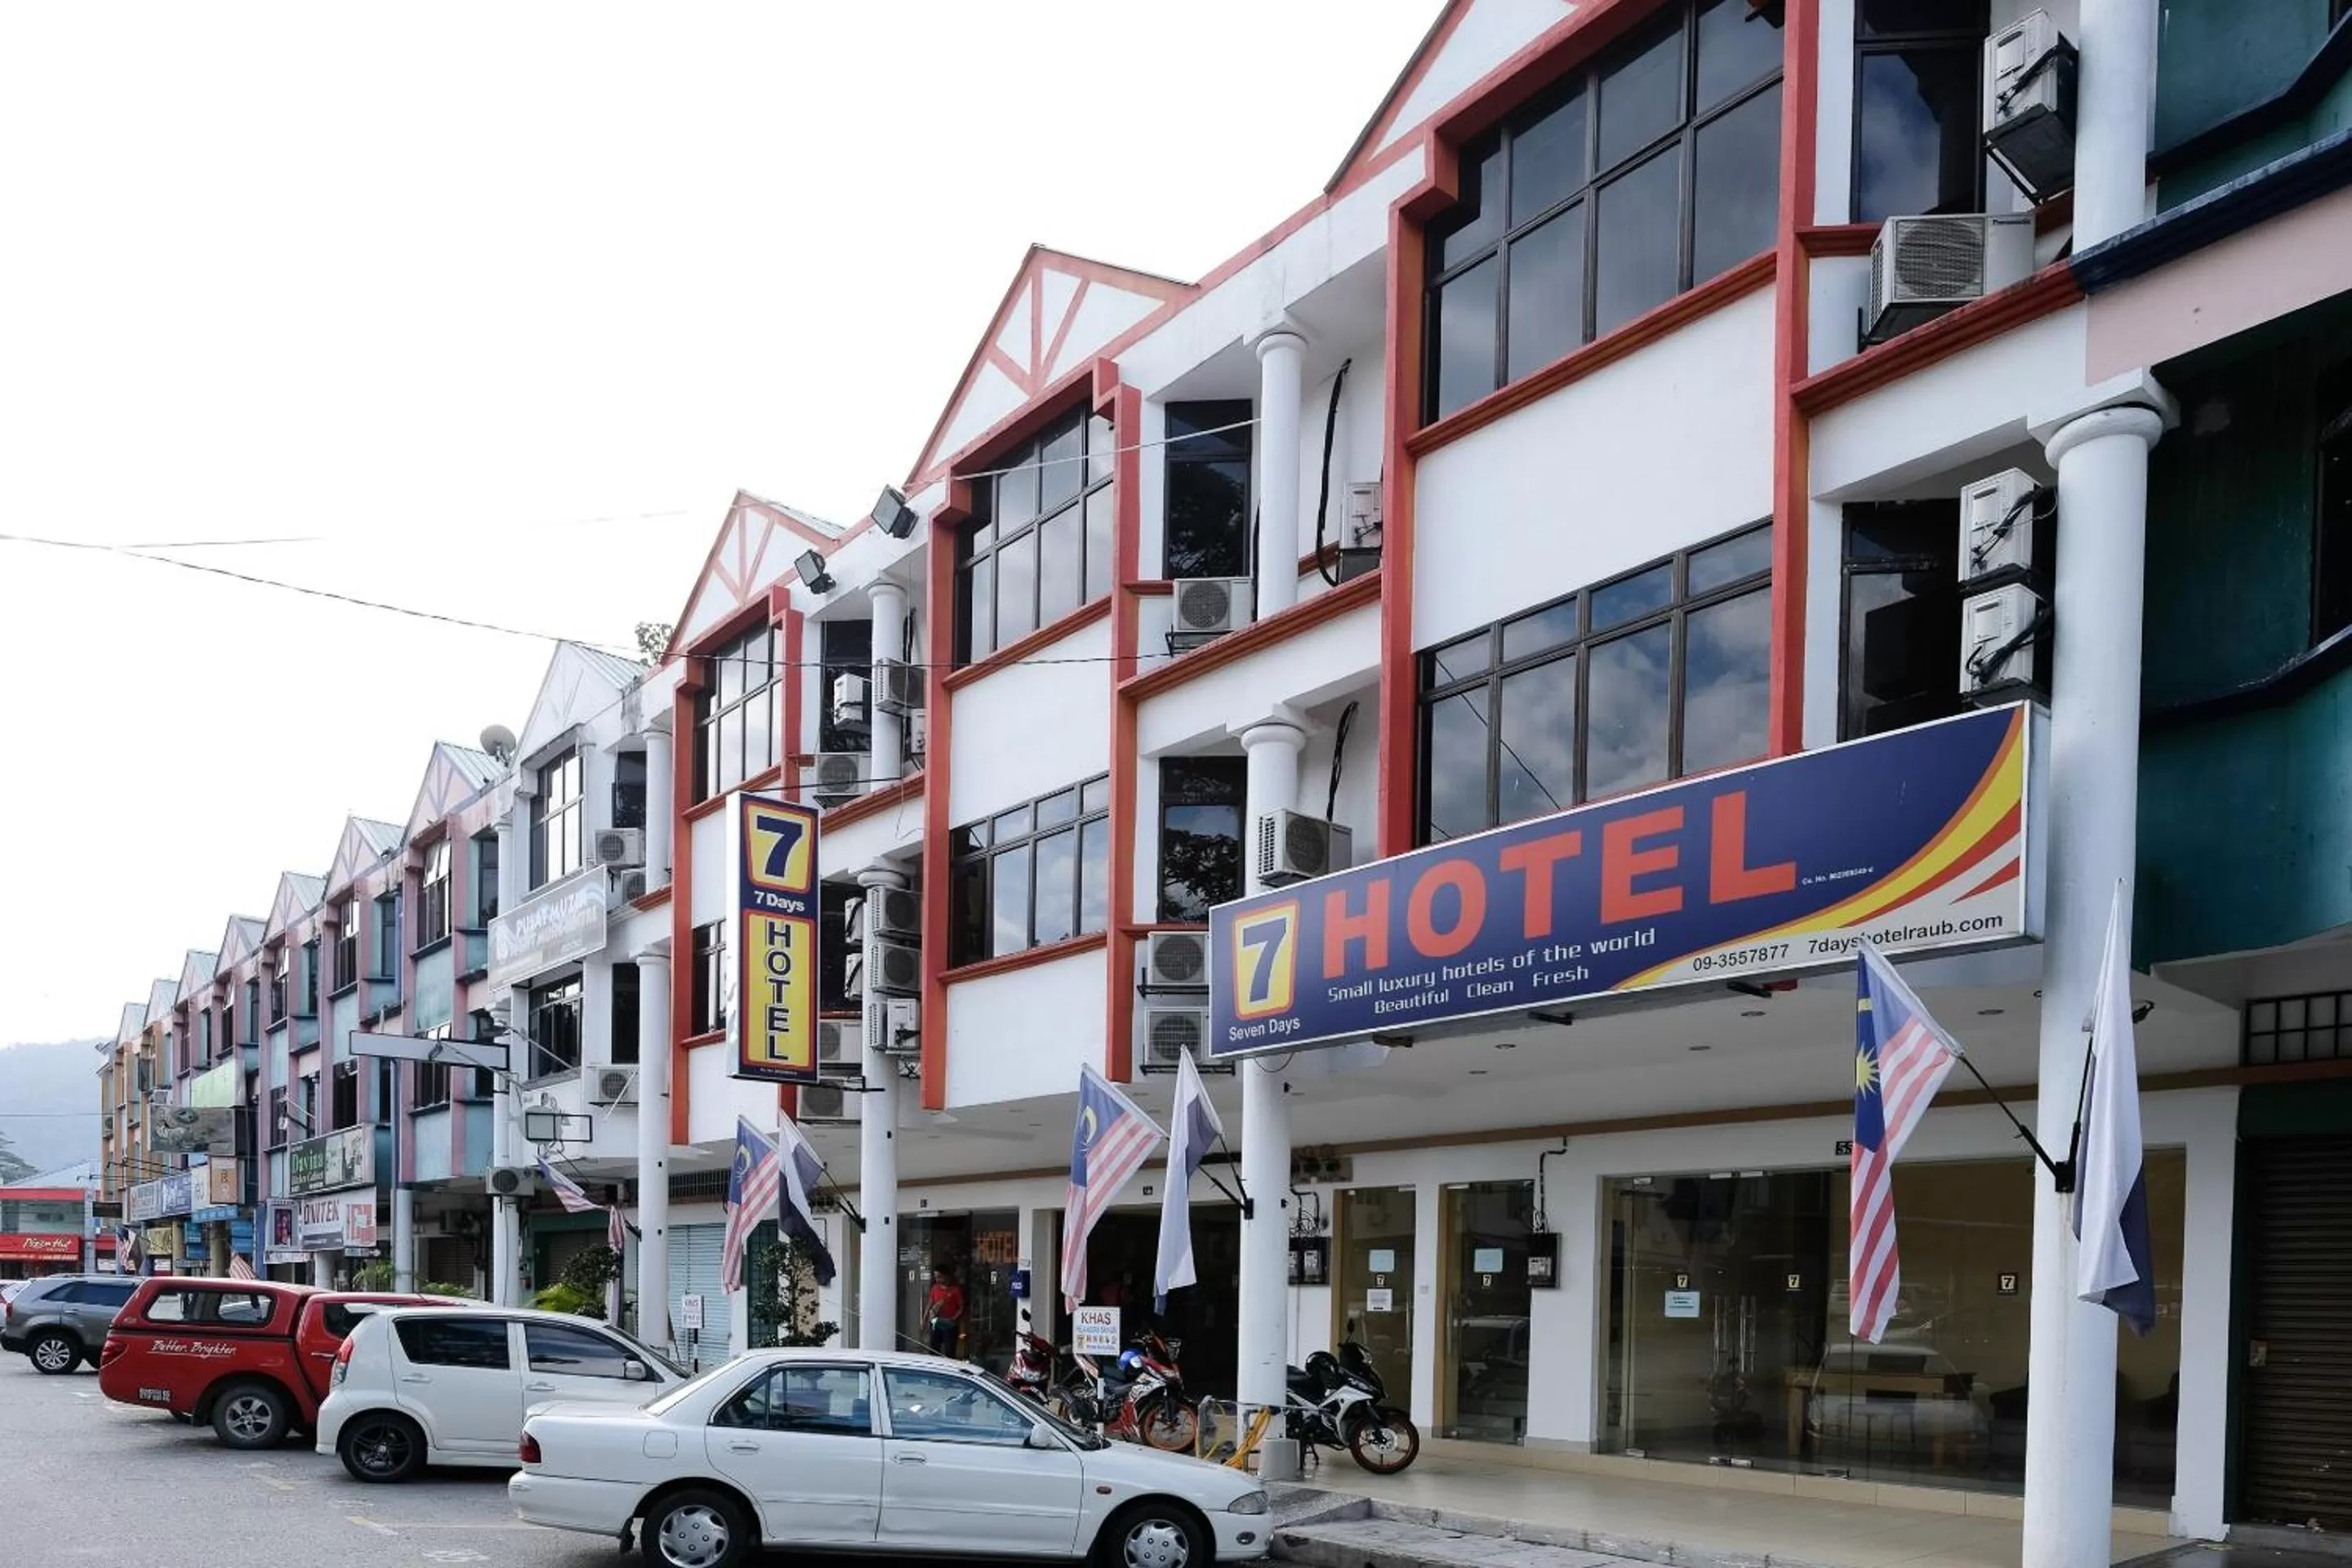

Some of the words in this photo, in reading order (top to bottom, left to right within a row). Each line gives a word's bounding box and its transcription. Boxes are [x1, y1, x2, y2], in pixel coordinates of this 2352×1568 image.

[756, 815, 802, 877] 7
[754, 890, 763, 904] 7
[766, 893, 805, 913] Days
[1323, 791, 1796, 979] HOTEL
[1242, 917, 1287, 1003] 7
[1328, 981, 1373, 1003] Small
[1379, 970, 1436, 993] luxury
[1442, 957, 1504, 981] hotels
[1512, 949, 1535, 969] of
[1543, 945, 1582, 963] the
[1590, 928, 1655, 955] world
[1693, 943, 1789, 972] 09-3557877
[766, 920, 791, 1061] HOTEL
[1374, 989, 1450, 1014] Beautiful
[1467, 980, 1514, 999] Clean
[1532, 965, 1589, 987] Fresh
[1228, 1022, 1265, 1041] Seven
[1270, 1018, 1301, 1038] Days
[1080, 1312, 1111, 1325] KHAS
